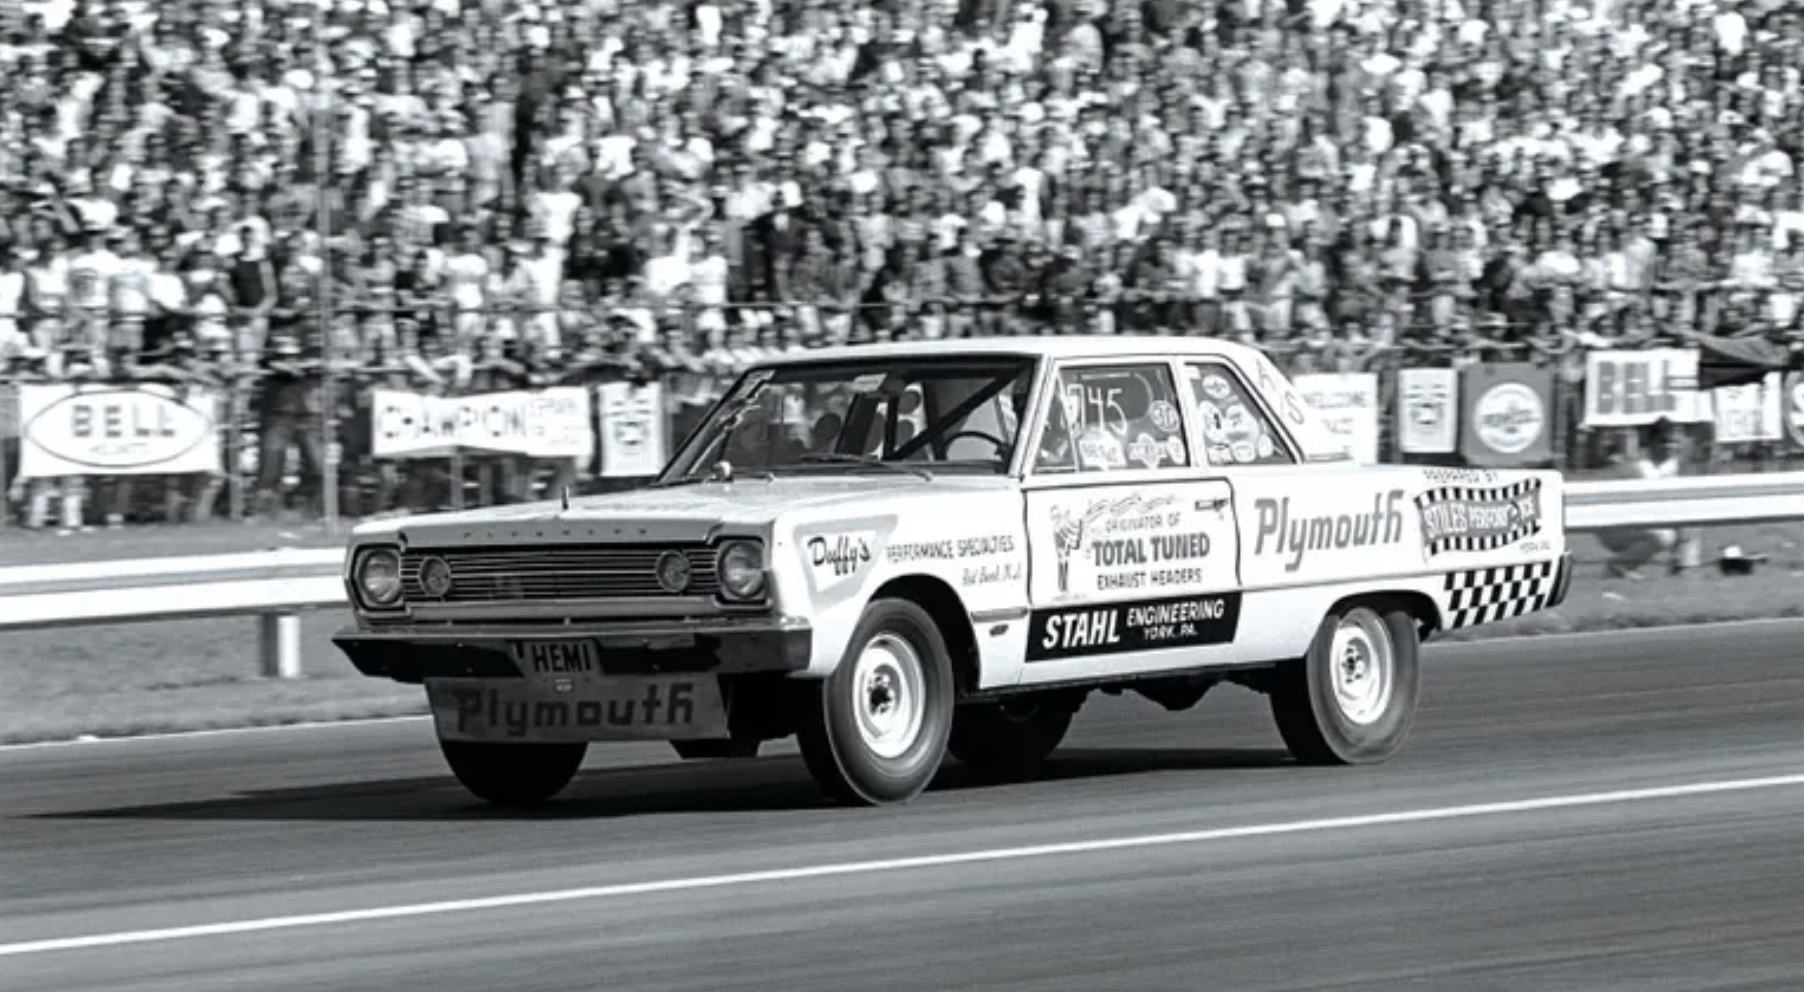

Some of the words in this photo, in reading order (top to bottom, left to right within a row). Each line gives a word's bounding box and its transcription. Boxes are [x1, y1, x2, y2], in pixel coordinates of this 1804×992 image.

[72, 404, 175, 438] BELL
[1167, 511, 1181, 527] OF
[1254, 490, 1404, 571] Plymouth
[807, 535, 871, 576] Duffy's
[886, 540, 955, 563] PERFORMANCE
[957, 535, 1014, 557] SPECIALTIES
[1091, 538, 1147, 567] TOTAL
[1151, 533, 1210, 562] TUNED
[1098, 571, 1147, 591] EXHAUST
[1150, 568, 1202, 587] HEADERS
[1042, 609, 1120, 649] STAHL
[1126, 598, 1225, 627] ENGINEERING
[531, 643, 591, 673] HEMI
[456, 682, 695, 737] Plymouth
